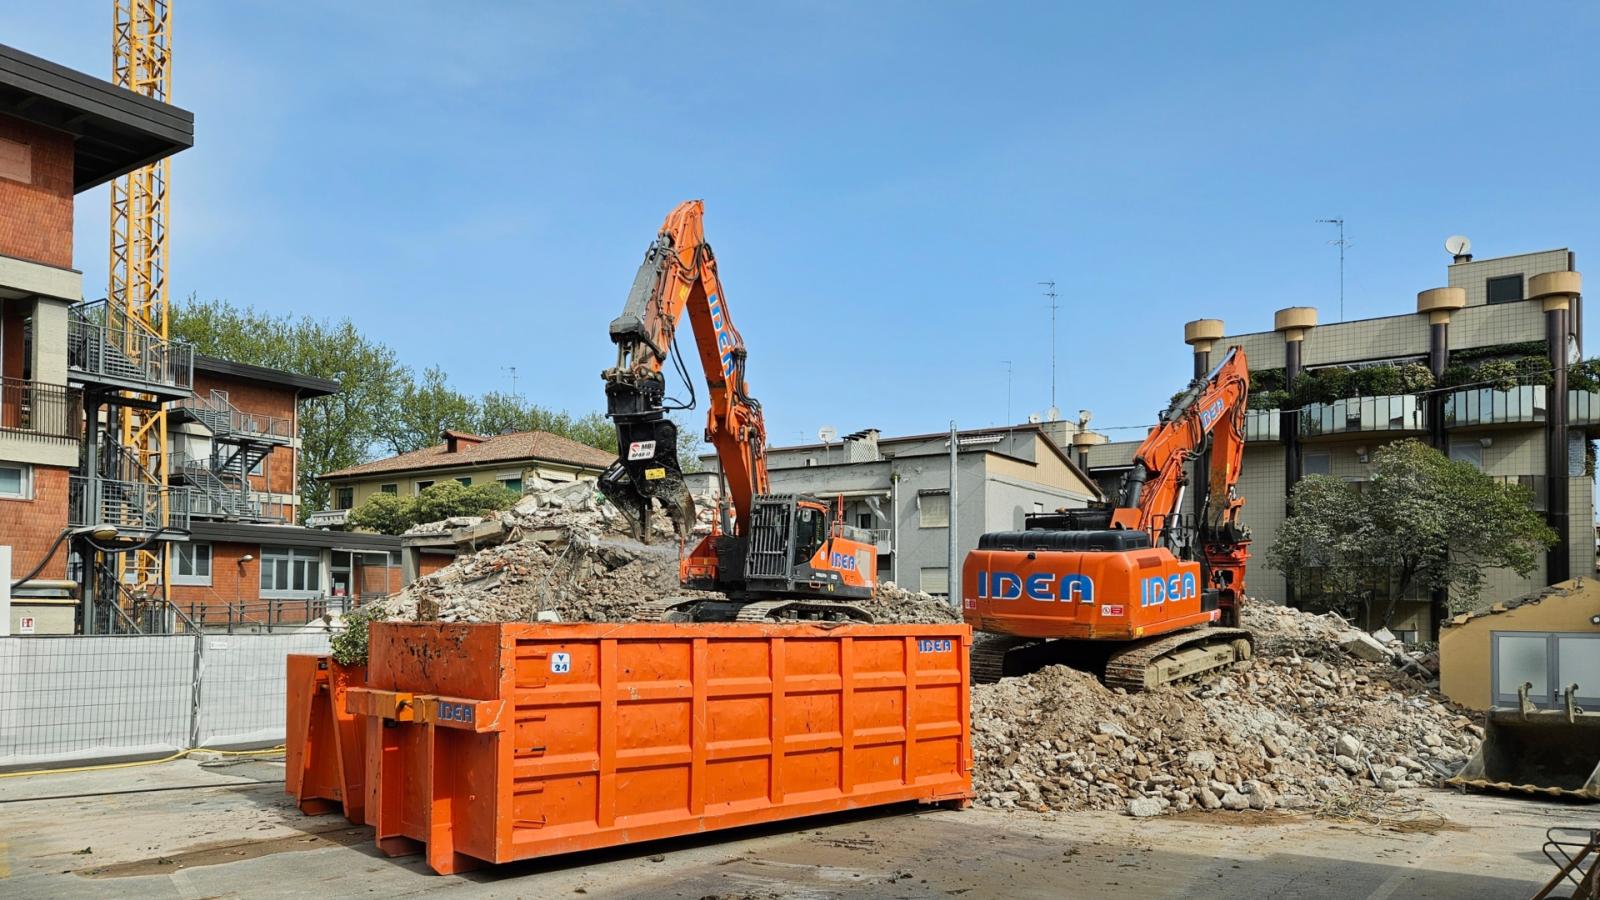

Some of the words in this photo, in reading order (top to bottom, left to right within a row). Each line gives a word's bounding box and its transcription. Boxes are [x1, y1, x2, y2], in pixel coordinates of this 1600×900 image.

[832, 552, 855, 571] IDEA
[977, 571, 1095, 603] IDEA
[1141, 571, 1196, 607] IDEA
[918, 639, 952, 653] IDEA
[558, 654, 564, 662] V
[438, 703, 473, 723] IDEA
